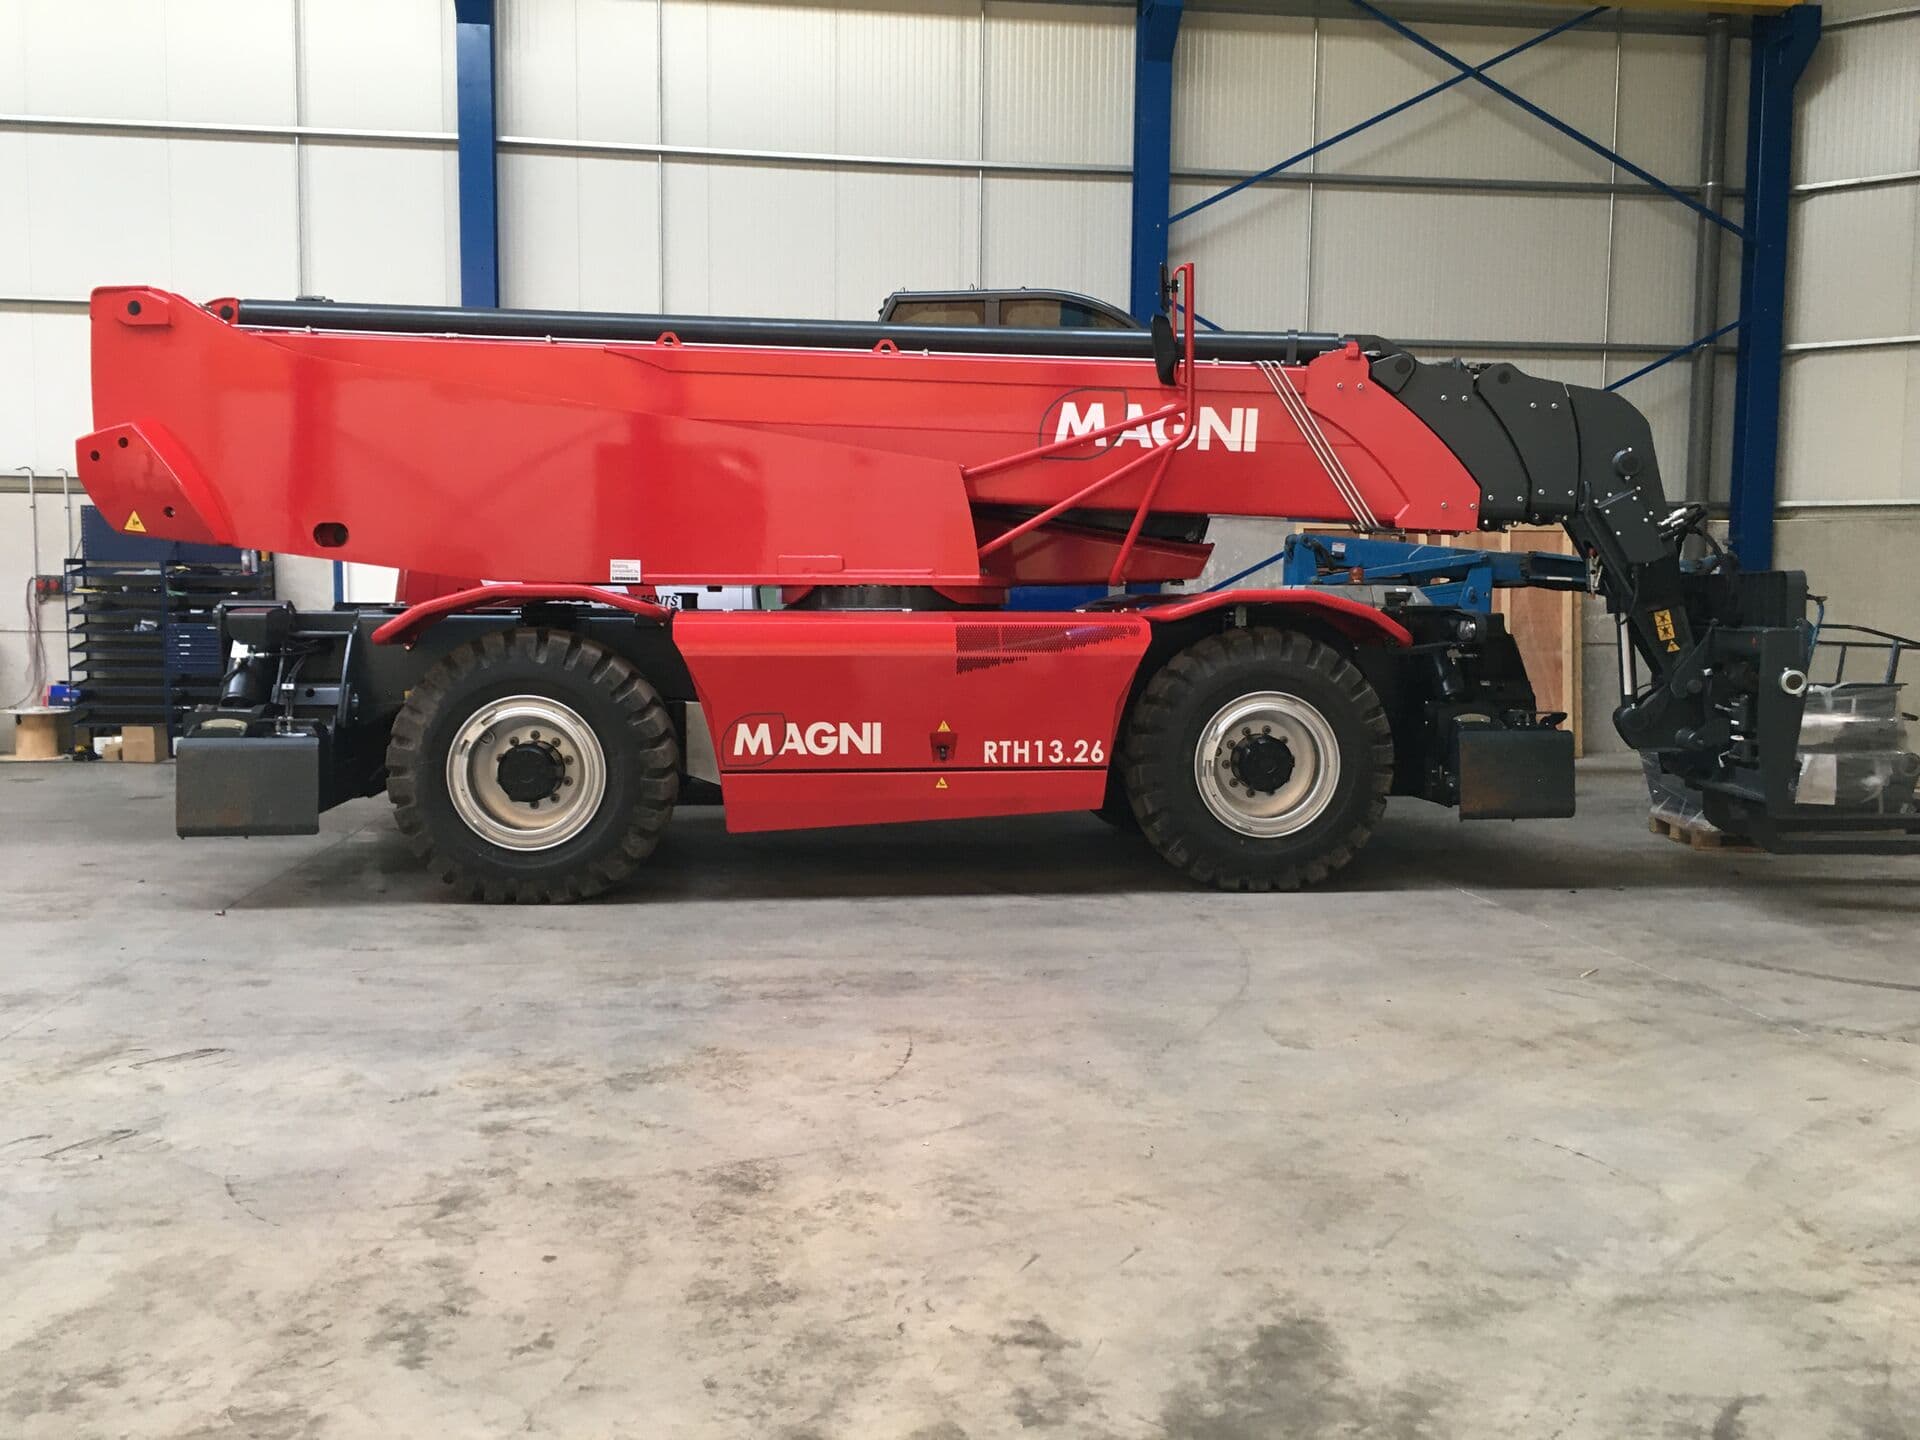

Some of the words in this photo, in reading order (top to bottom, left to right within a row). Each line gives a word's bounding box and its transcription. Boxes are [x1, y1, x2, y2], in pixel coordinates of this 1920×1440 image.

[1054, 402, 1259, 452] MAGNI
[733, 721, 882, 756] MAGNI
[984, 739, 1104, 764] RTH13.26
